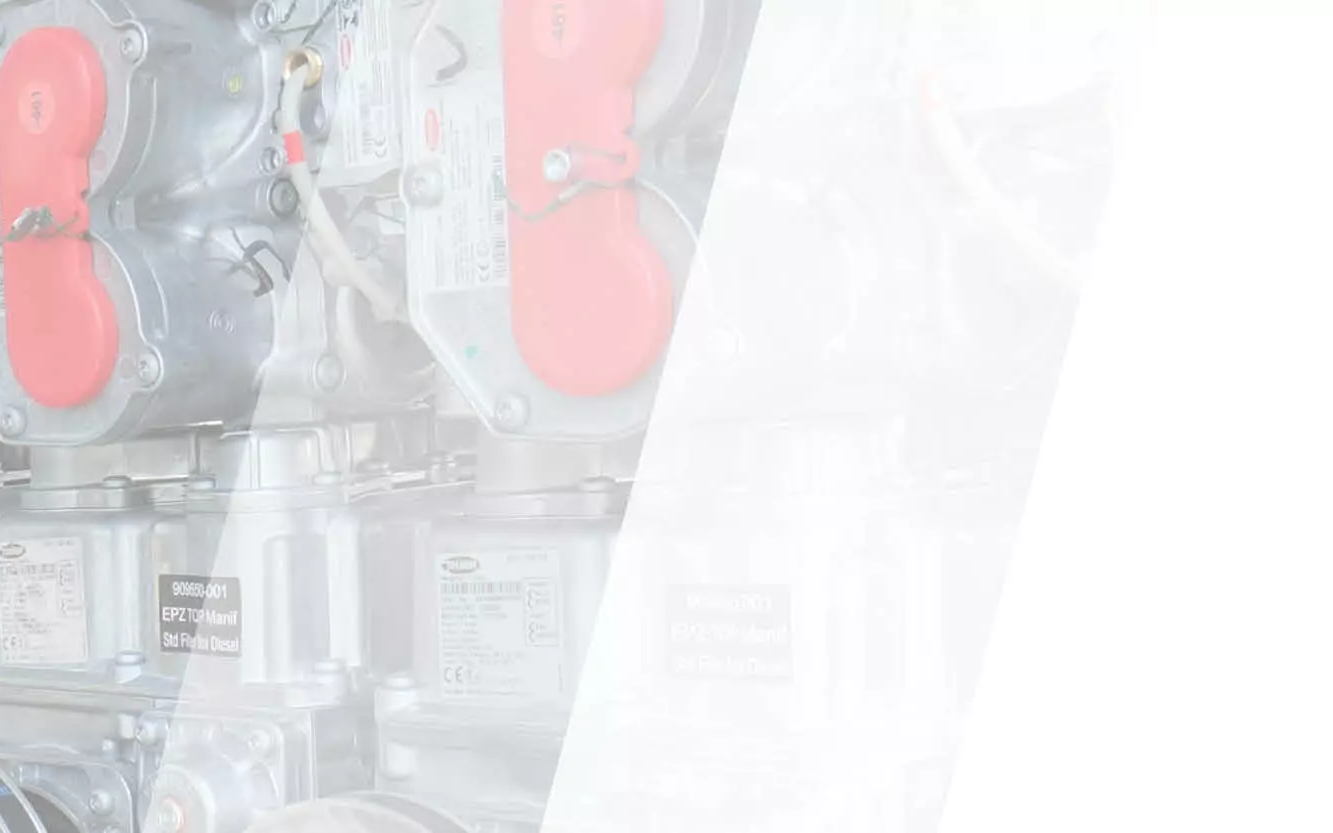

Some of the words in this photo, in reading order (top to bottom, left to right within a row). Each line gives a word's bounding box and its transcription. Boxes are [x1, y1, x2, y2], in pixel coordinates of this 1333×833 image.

[162, 606, 186, 622] EPZ
[206, 608, 238, 626] Manif
[163, 631, 179, 648] Std
[210, 635, 239, 652] Diesel
